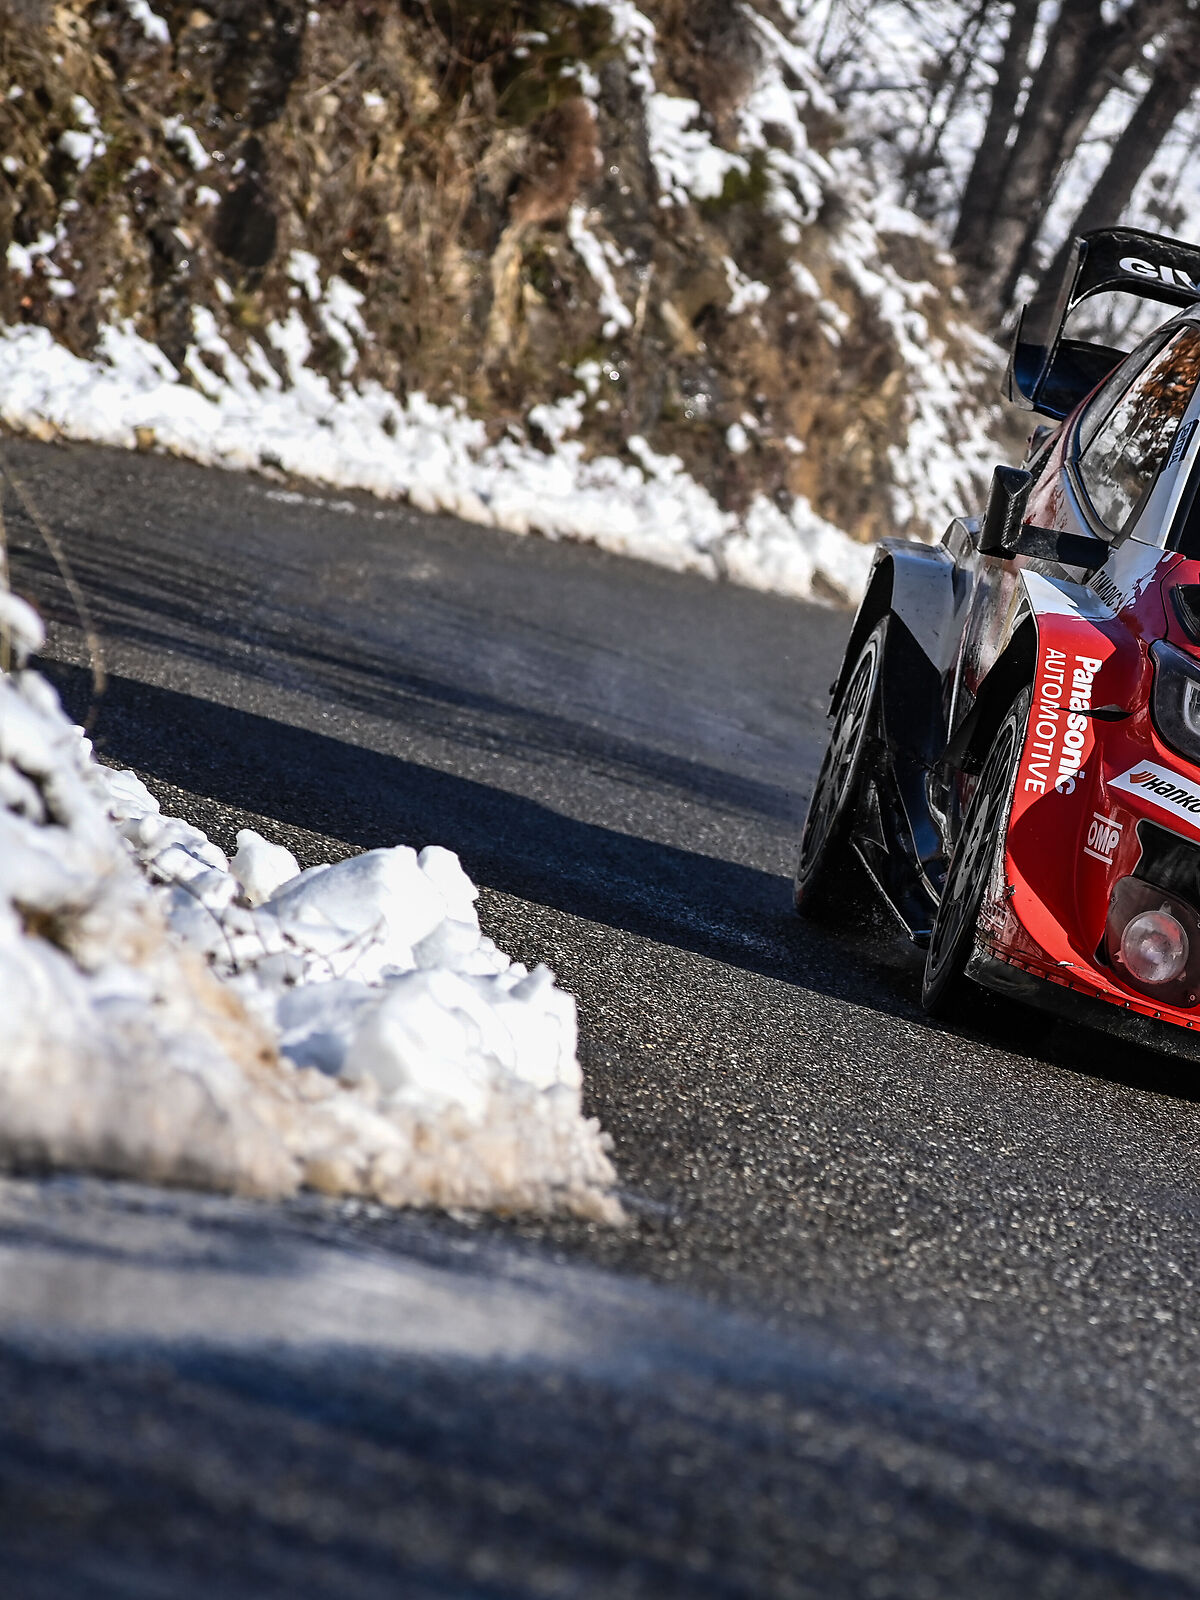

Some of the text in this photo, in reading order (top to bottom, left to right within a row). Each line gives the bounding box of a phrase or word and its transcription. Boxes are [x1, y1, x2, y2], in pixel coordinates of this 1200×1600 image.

[1090, 570, 1122, 607] TAMADIC
[1024, 647, 1067, 795] AUTOMOTIVE
[1054, 655, 1102, 795] Panasonic
[1087, 820, 1120, 855] OMP
